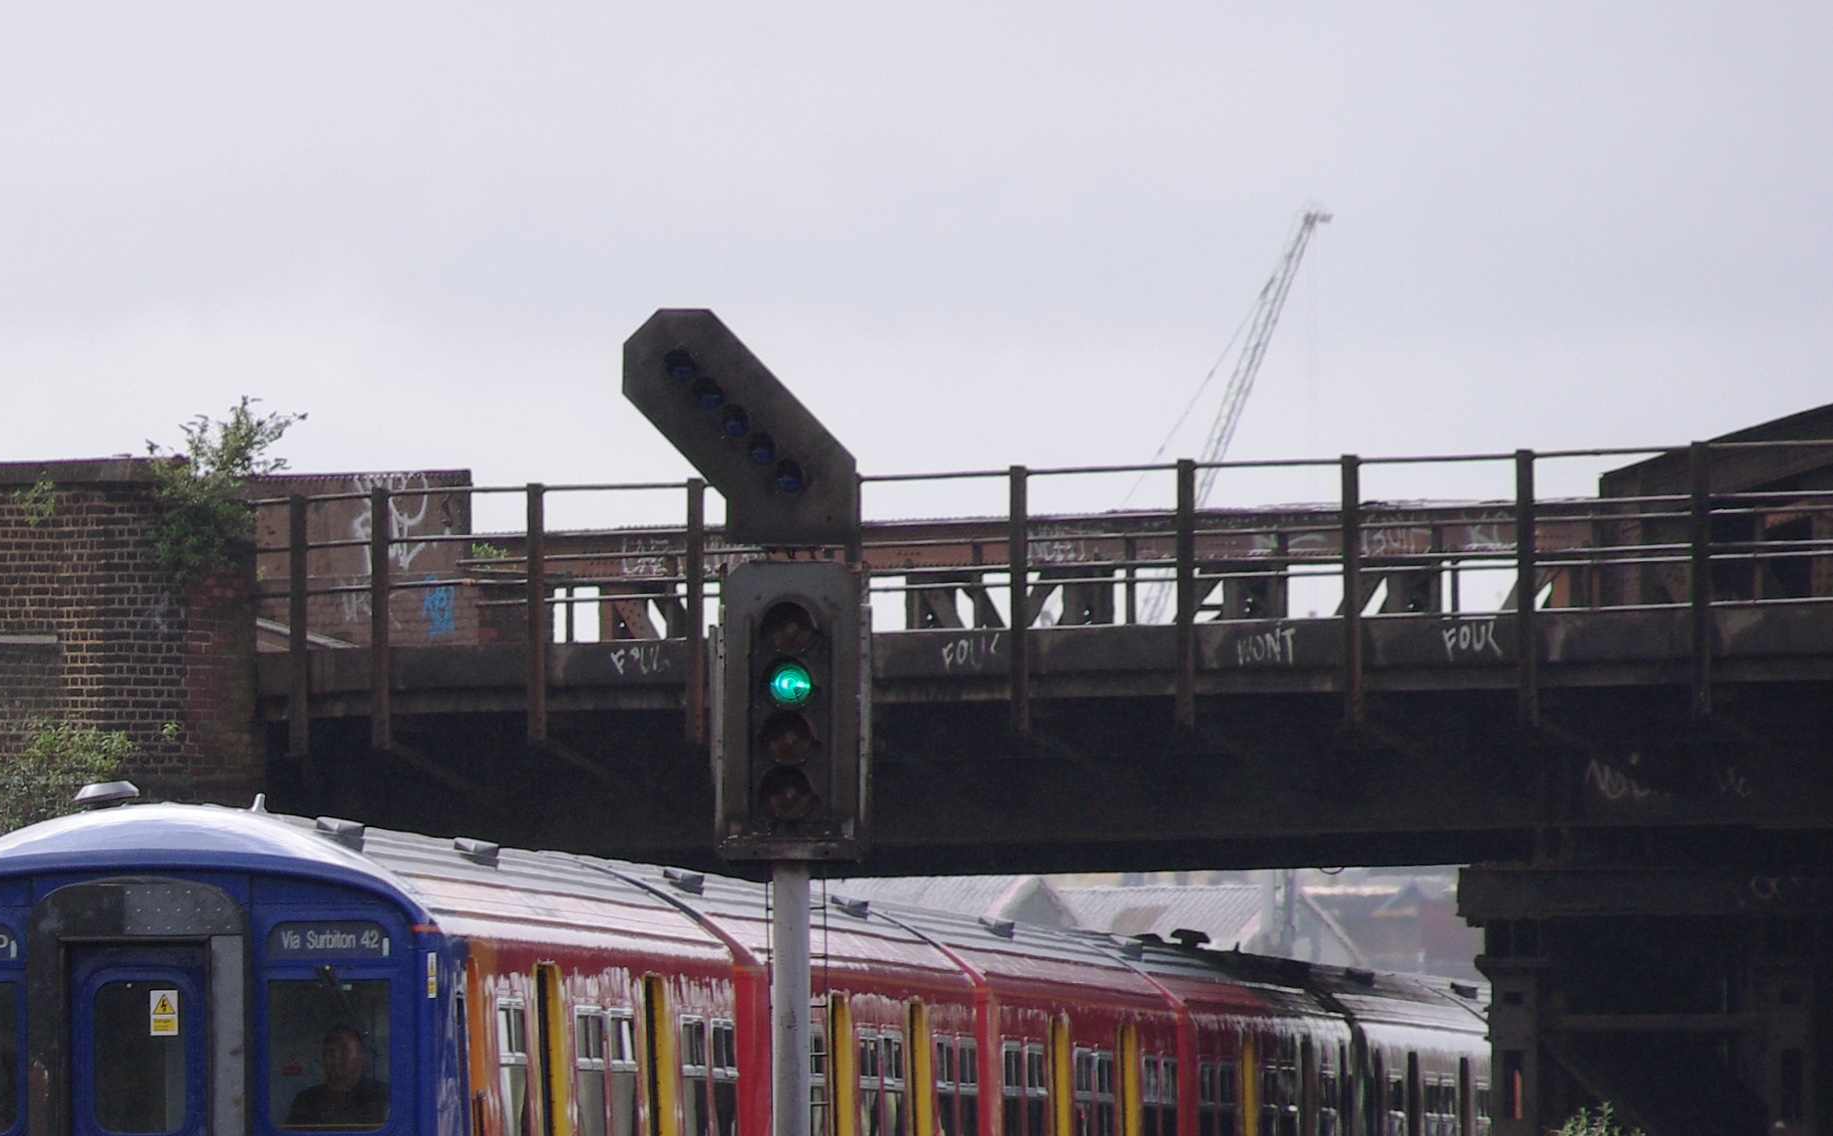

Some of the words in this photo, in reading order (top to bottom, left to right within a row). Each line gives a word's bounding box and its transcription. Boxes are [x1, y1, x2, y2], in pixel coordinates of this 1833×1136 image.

[281, 930, 301, 949] Via
[306, 929, 356, 949] Surbiton
[361, 930, 380, 949] 42
